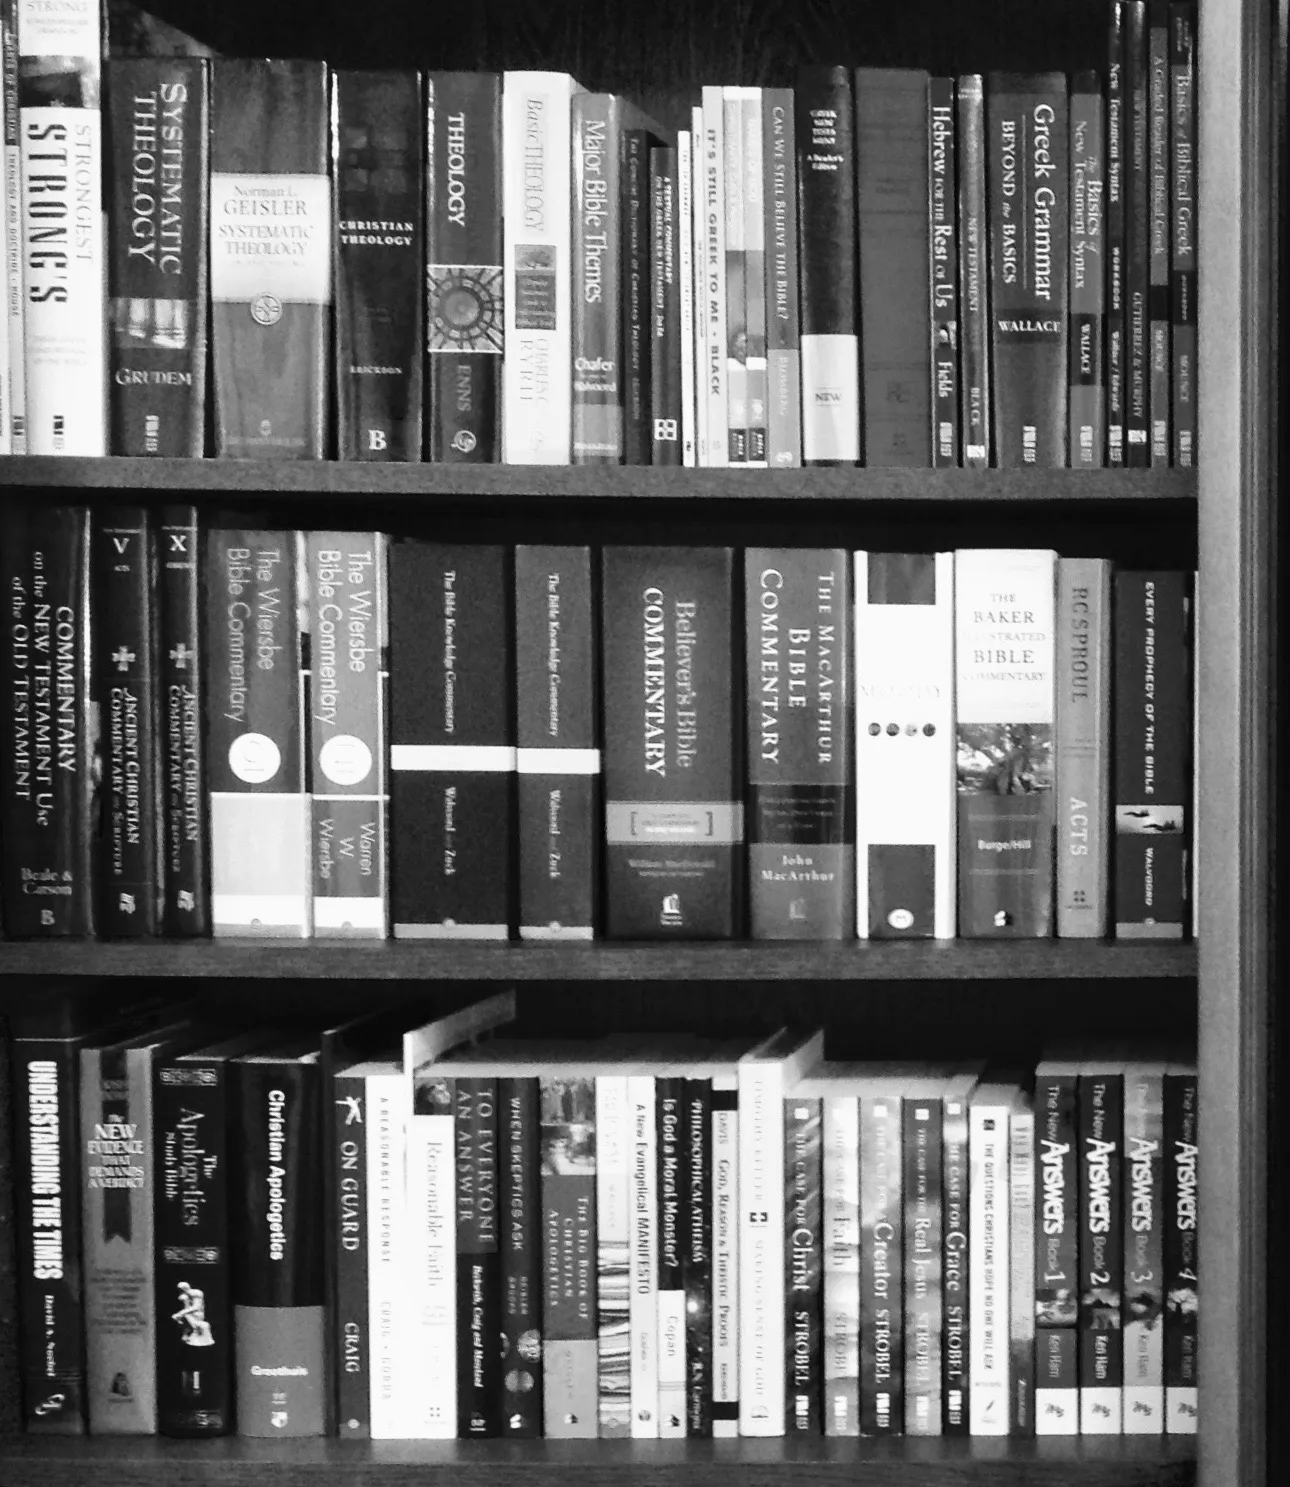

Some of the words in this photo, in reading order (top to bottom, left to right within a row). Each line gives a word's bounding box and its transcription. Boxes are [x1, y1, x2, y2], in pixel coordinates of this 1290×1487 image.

[584, 120, 606, 176] Major
[933, 106, 951, 174] Hebrew
[1001, 120, 1016, 197] BEYOND
[1033, 104, 1056, 178] Greek
[126, 91, 157, 264] THEOLOGY
[158, 83, 188, 277] SYSTEMATIC
[446, 112, 465, 228] THEOLOGY
[707, 166, 718, 205] STILL
[27, 123, 69, 304] STRONG'S
[223, 199, 309, 217] GEISLER
[339, 220, 414, 232] CHRISTIAN
[584, 179, 608, 228] Bible
[1086, 180, 1104, 236] Basics
[341, 235, 412, 247] THEOLOGY
[709, 213, 719, 265] GREEK
[934, 225, 952, 260] Rest
[1002, 224, 1017, 284] BASICS
[1034, 187, 1056, 300] Grammar
[582, 232, 609, 304] Themes
[710, 274, 719, 293] TO
[710, 299, 719, 323] ME
[935, 285, 953, 308] Us
[999, 320, 1061, 333] WALLACE
[115, 368, 192, 387] GRUDEM
[457, 364, 473, 413] ENNS
[711, 346, 721, 396] BLACK
[938, 361, 953, 398] Fields
[227, 548, 251, 595] Bible
[256, 551, 280, 581] The
[317, 550, 342, 598] Bible
[347, 551, 372, 585] The
[818, 571, 835, 614] THE
[33, 603, 51, 653] NEW
[257, 588, 282, 670] Wiersbe
[973, 611, 1035, 624] BAKER
[1145, 582, 1155, 623] EVERY
[12, 624, 29, 669] OLD
[348, 590, 375, 672] Wiersbe
[675, 601, 697, 711] Believer's
[974, 650, 1035, 664] BIBLE
[55, 606, 77, 773] COMMENTARY
[224, 602, 251, 723] Commentary
[313, 604, 342, 725] Commentary
[643, 587, 666, 778] COMMENTARY
[760, 568, 784, 764] COMMENTARY
[788, 628, 811, 708] BIBLE
[1145, 628, 1155, 699] PROPHECY
[817, 625, 835, 764] MACARTHUR
[1145, 703, 1155, 721] OF
[13, 675, 31, 800] TESTAMENT
[34, 661, 53, 785] TESTAMENT
[110, 687, 124, 795] COMMENTARY
[676, 711, 697, 768] Bible
[1145, 727, 1155, 751] THE
[124, 760, 140, 844] CHRISTIAN
[1145, 756, 1155, 795] BIBLE
[35, 793, 54, 827] Use
[1069, 796, 1090, 857] ACTS
[27, 1060, 61, 1195] UNDERSTANDING
[268, 1090, 286, 1162] Christian
[458, 1091, 472, 1120] AN
[478, 1088, 493, 1117] TO
[663, 1114, 678, 1143] God
[340, 1141, 359, 1170] ON
[458, 1131, 474, 1221] ANSWER
[663, 1157, 678, 1197] Moral
[31, 1197, 62, 1227] THE
[266, 1165, 287, 1260] Apologetics
[341, 1177, 360, 1251] GUARD
[478, 1129, 494, 1243] EVERYONE
[33, 1230, 63, 1279] TIMES
[663, 1201, 679, 1268] Monster?
[792, 1228, 814, 1292] Christ
[873, 1222, 894, 1299] Creator
[946, 1231, 966, 1291] Grace
[1090, 1271, 1110, 1285] 2
[344, 1322, 360, 1373] CRAIG
[795, 1311, 810, 1385] STROBEL
[875, 1309, 891, 1383] STROBEL
[948, 1306, 963, 1381] STROBEL
